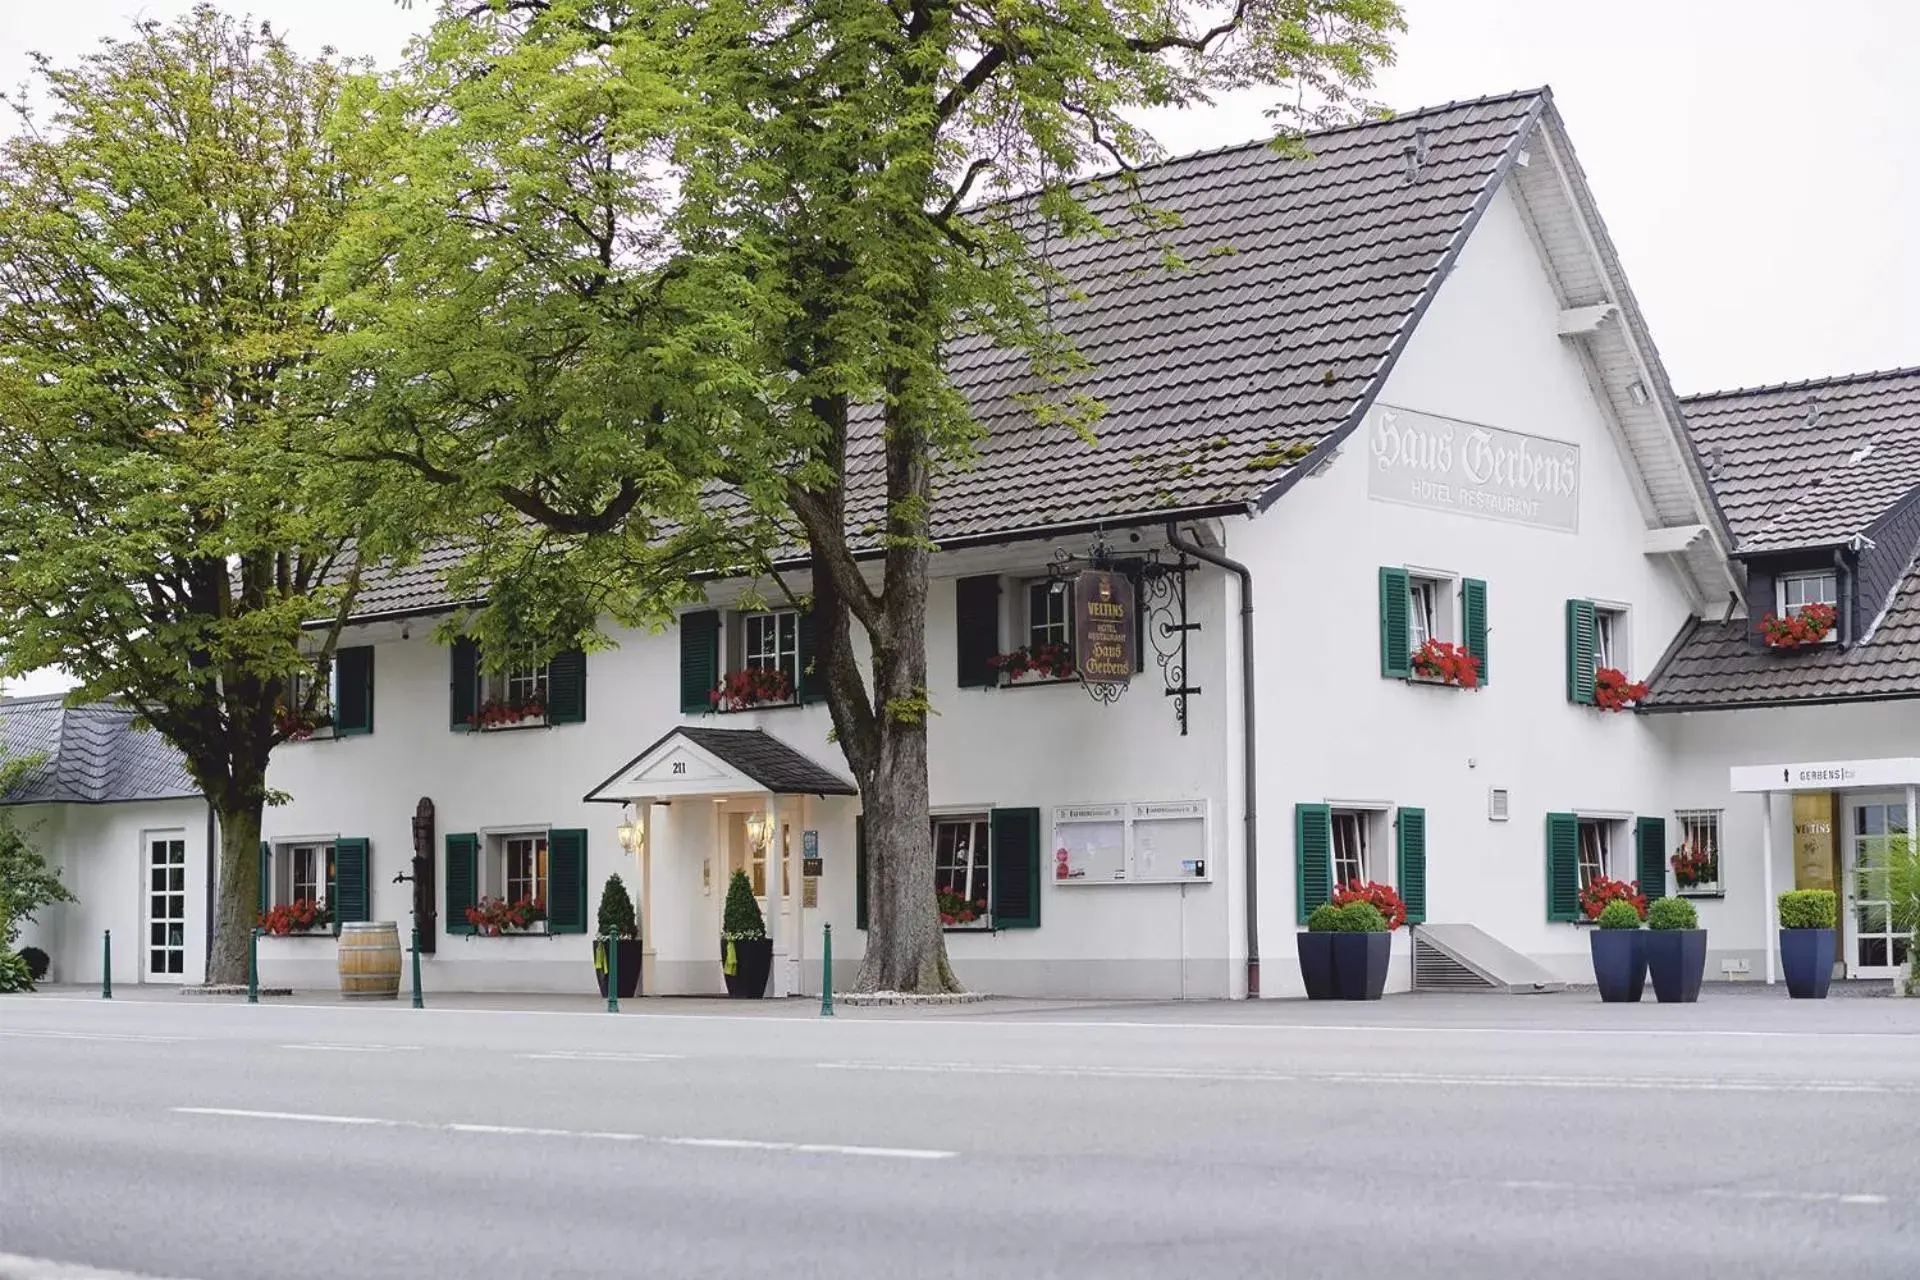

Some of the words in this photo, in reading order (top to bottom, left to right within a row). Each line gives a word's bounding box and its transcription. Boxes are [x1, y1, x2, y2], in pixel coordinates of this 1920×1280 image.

[1371, 411, 1455, 473] Haus
[1463, 428, 1576, 498] Gerbens
[1411, 478, 1454, 504] HOTEL
[1459, 487, 1540, 517] RESTAURANT
[1088, 601, 1124, 617] VELTINS
[1092, 642, 1122, 658] Haus
[672, 762, 686, 774] 211
